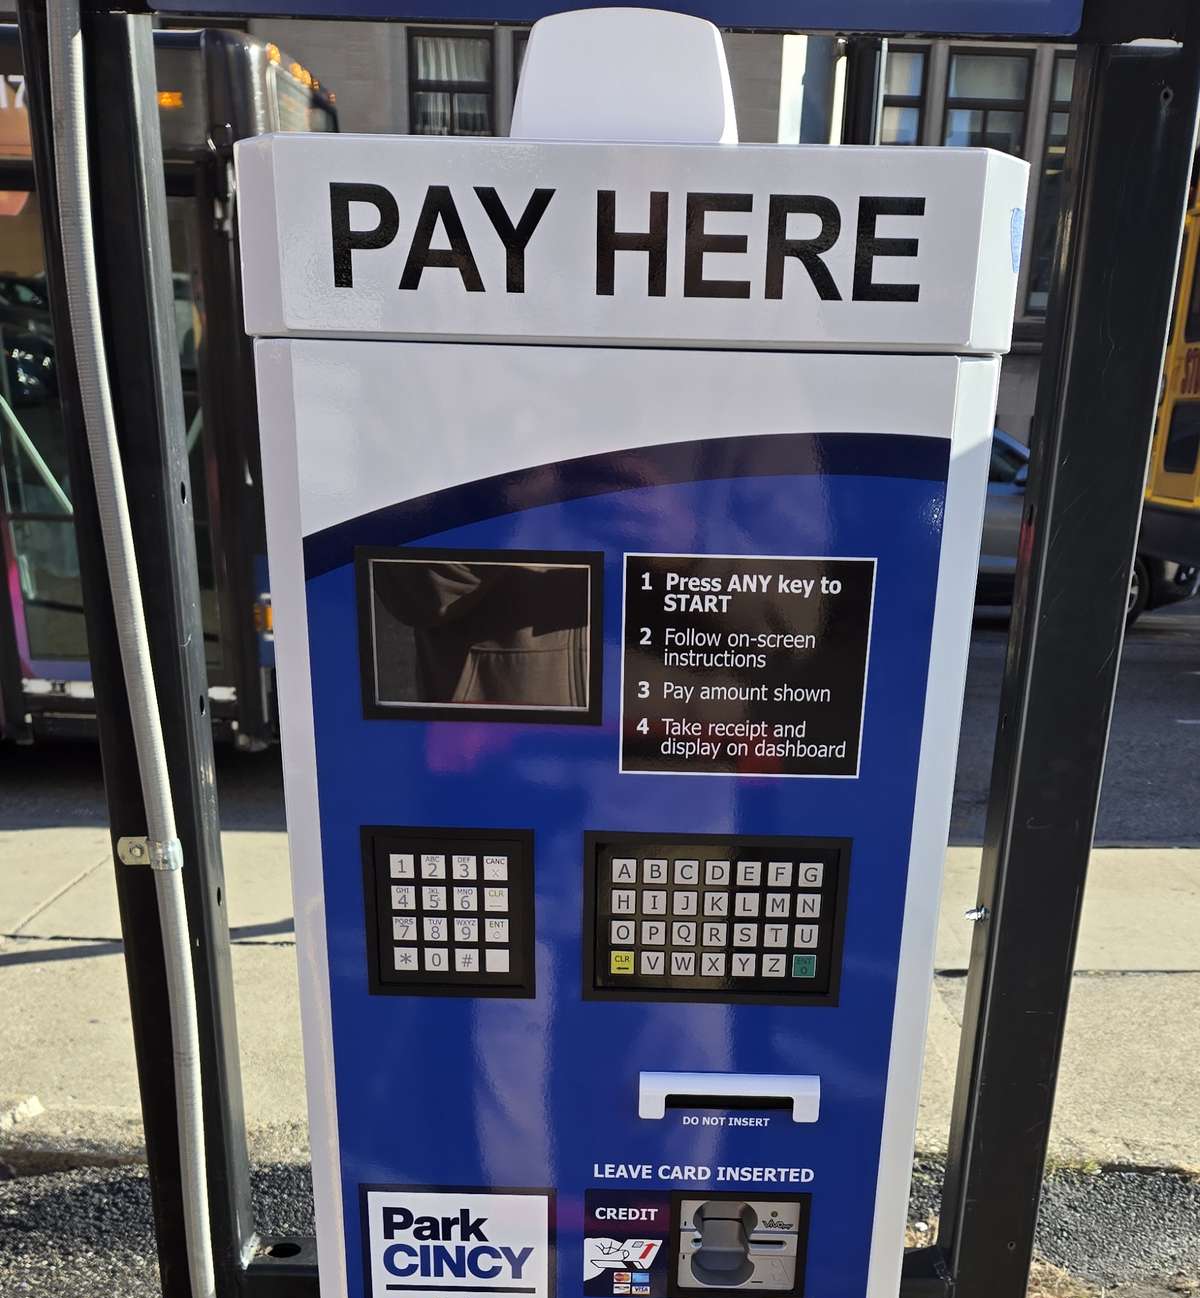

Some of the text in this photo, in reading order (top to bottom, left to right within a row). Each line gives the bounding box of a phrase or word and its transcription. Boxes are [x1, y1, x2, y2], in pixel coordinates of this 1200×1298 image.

[328, 182, 926, 303] PAY HERE
[641, 572, 842, 598] 1 Press ANY key to
[663, 595, 732, 613] START
[639, 628, 816, 649] 2 Follow on-screen
[663, 649, 767, 668] instructions
[637, 681, 831, 703] 3 Pay amount shown
[636, 718, 806, 741] 4 Take receipt and
[660, 738, 846, 759] display on dashboard
[398, 859, 469, 878] 1 2 3
[618, 864, 817, 882] A B C D E F G
[398, 895, 470, 909] 4 5 6
[618, 895, 815, 913] H I J K L M N
[400, 925, 471, 940] 7 8 9
[616, 925, 812, 943] O P Q R S T U
[614, 955, 779, 972] CLR V W X Y Z
[683, 1116, 770, 1127] DO NOT INSERT
[593, 1164, 815, 1183] LEAVE CARD INSERTED
[595, 1208, 658, 1221] CREDIT
[382, 1207, 489, 1242] Park
[383, 1243, 535, 1279] CINCY
